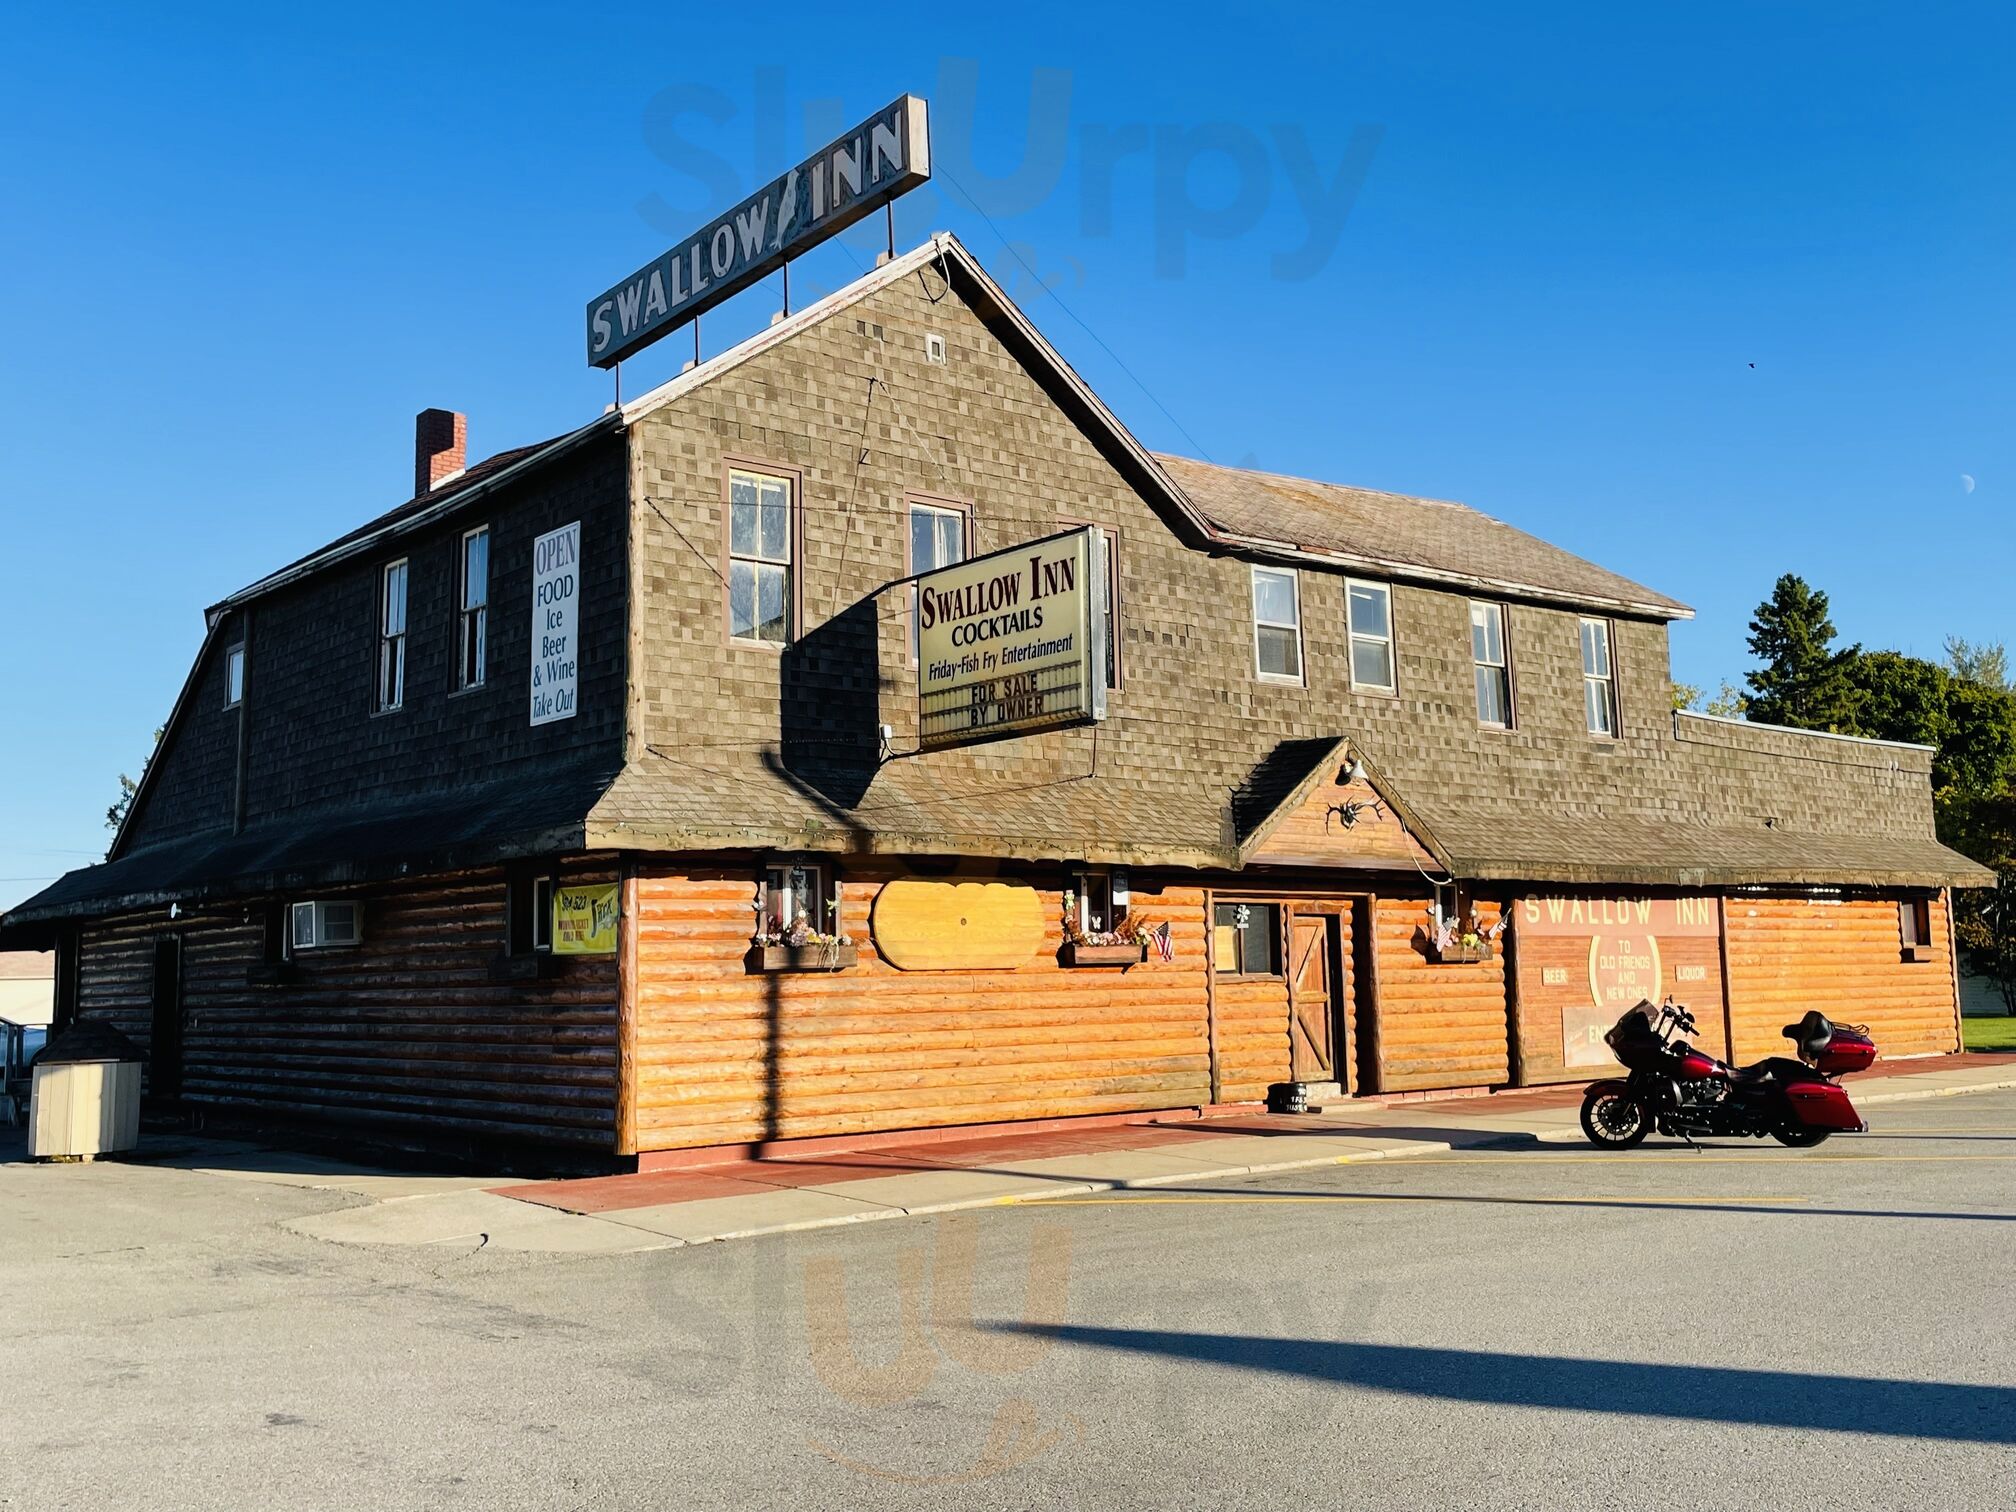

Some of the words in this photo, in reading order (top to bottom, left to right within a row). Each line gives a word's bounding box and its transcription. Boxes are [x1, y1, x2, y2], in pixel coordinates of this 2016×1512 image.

[592, 196, 770, 353] SWALLOW
[811, 109, 903, 222] INN
[536, 529, 577, 576] OPEN
[537, 574, 574, 607] FOOD
[1029, 556, 1076, 601] INN
[546, 609, 563, 631] Ice
[951, 606, 1044, 648] COCKTAILS
[542, 635, 567, 659] Beer
[928, 655, 980, 681] Friday-Fish
[982, 651, 999, 674] Fry
[1001, 633, 1074, 666] Entertainment
[533, 664, 542, 687] &
[546, 657, 575, 684] Wine
[971, 683, 995, 702] FOR
[1004, 673, 1038, 699] SALE
[533, 692, 552, 719] Take
[556, 688, 574, 713] Out
[970, 706, 987, 727] BY
[999, 695, 1044, 719] OWNER
[1524, 894, 1652, 926] SWALLOW
[1675, 896, 1710, 926] INN
[1618, 940, 1631, 954] TO
[1543, 968, 1568, 984] BEER
[1600, 956, 1615, 970] OLD
[1618, 956, 1650, 970] FRIENDS
[1618, 970, 1636, 985] AND
[1676, 966, 1706, 980] LIQUOR
[1606, 986, 1625, 1001] NEW
[1627, 985, 1648, 1000] ONES
